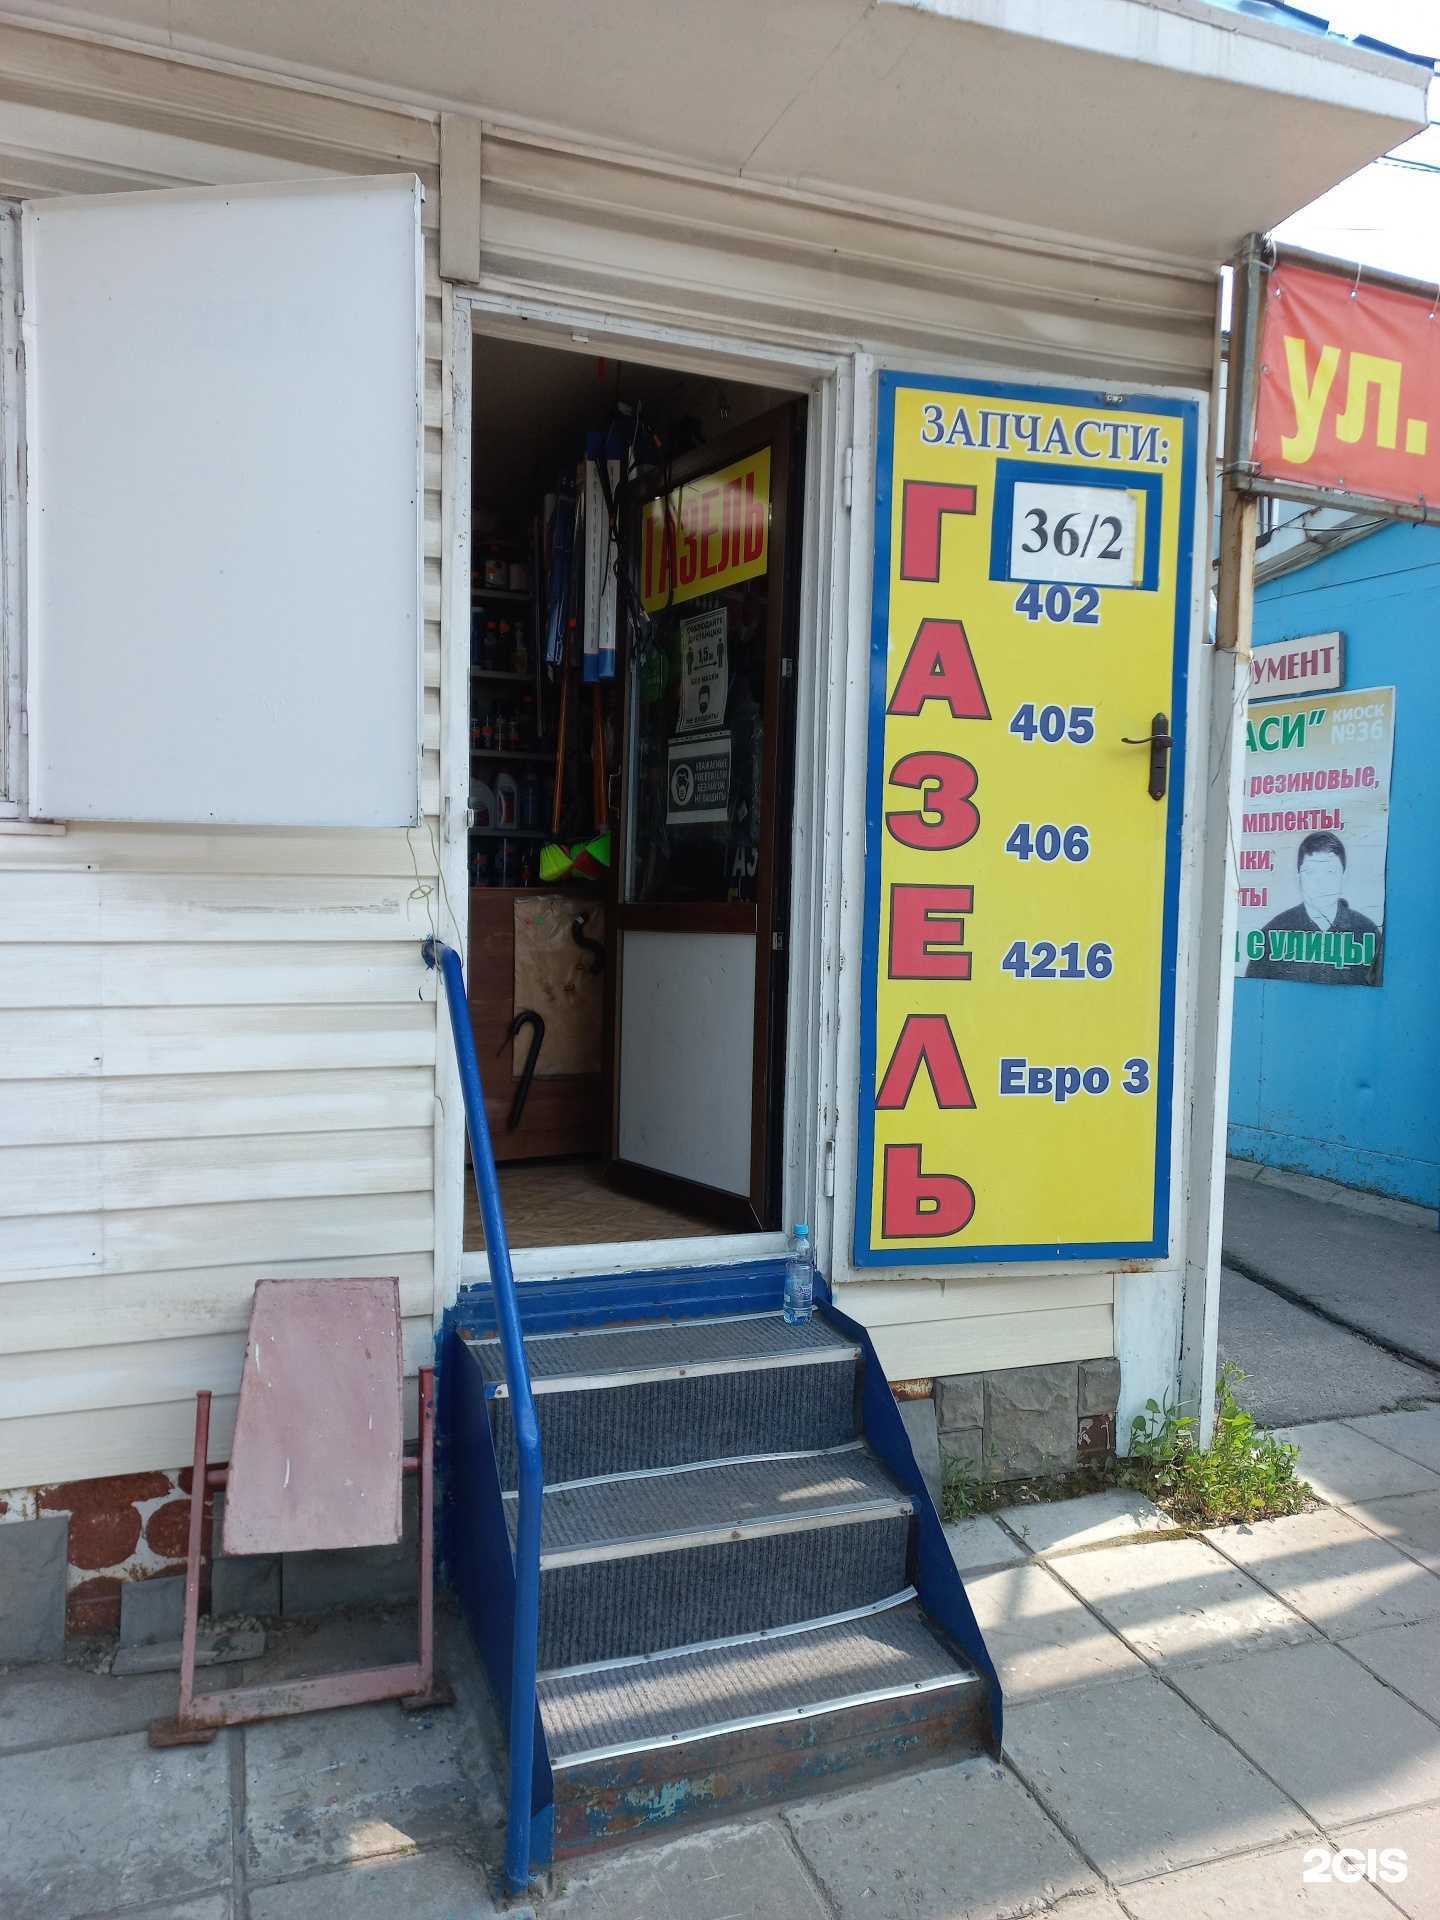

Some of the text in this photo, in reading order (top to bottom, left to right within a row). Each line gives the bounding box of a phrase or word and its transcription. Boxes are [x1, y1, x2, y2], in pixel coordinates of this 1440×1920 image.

[1280, 334, 1428, 464] ул.
[920, 404, 1170, 465] ЗАПЧАСТИ:
[1020, 507, 1124, 561] 36/2
[1015, 584, 1100, 624] 402
[1010, 704, 1096, 745] 405
[1331, 719, 1384, 745] №36
[1332, 703, 1385, 722] КИОСК
[1250, 765, 1380, 798] резиновые,
[875, 479, 993, 1240] ГАЗЕЛЬ
[1005, 823, 1090, 863] 406
[1001, 940, 1114, 980] 4216
[1269, 929, 1376, 969] УЛИЦЫ
[999, 1057, 1151, 1102] Евро 3
